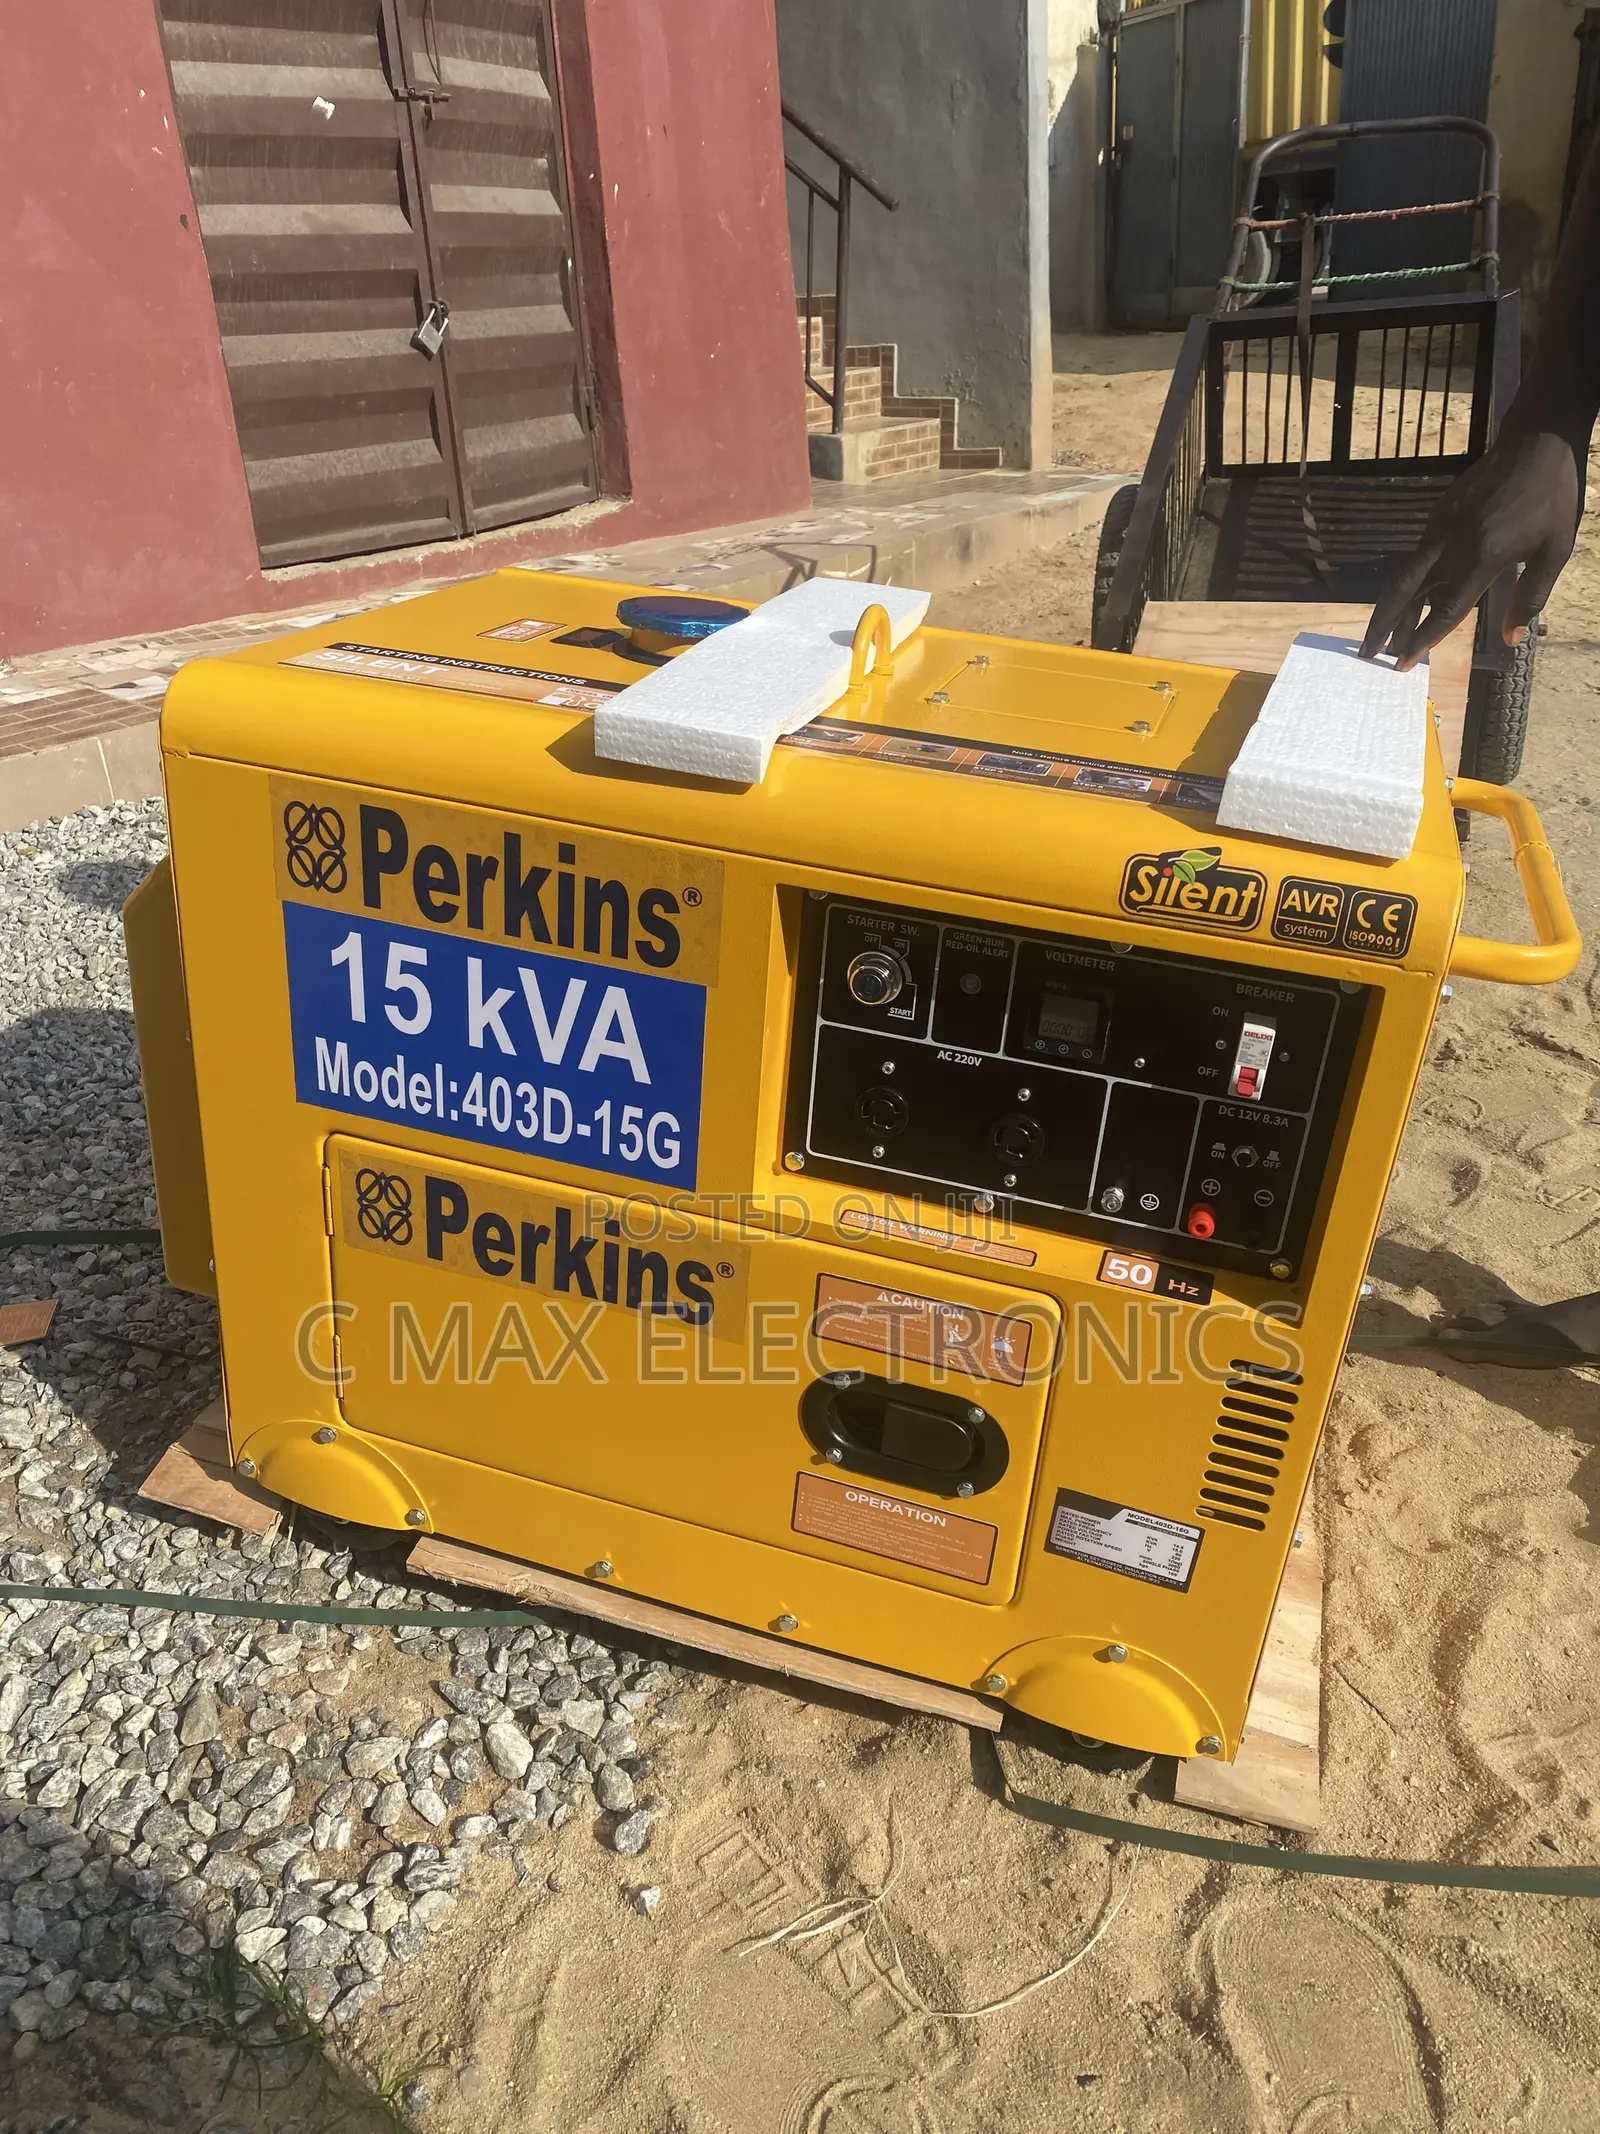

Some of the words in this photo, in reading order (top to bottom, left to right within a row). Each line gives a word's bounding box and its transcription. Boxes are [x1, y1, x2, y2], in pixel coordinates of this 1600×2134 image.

[316, 652, 449, 675] SILENT
[342, 645, 438, 662] STARTING
[440, 658, 587, 685] INSTRUCTIONS
[1040, 754, 1069, 762] Before
[1072, 759, 1105, 768] starting
[1107, 764, 1150, 775] generator
[1129, 864, 1257, 917] Silent
[1282, 888, 1339, 918] AVR
[1357, 899, 1402, 933] CE
[847, 914, 895, 932] STARTER
[900, 924, 920, 937] SW.
[1284, 921, 1328, 940] system
[864, 934, 879, 943] OFF
[894, 940, 906, 949] ON
[953, 932, 1005, 948] GREEN-RUN
[946, 941, 980, 953] RED-OIL
[982, 947, 1010, 959] ALERT
[1045, 950, 1116, 971] VOLTMETER
[1236, 984, 1294, 1003] BREAKER
[330, 932, 433, 1036] 15
[467, 956, 652, 1085] kVA
[889, 1007, 912, 1017] START
[1212, 1006, 1229, 1017] ON
[1244, 1031, 1273, 1041] DELIXI
[937, 1050, 952, 1061] AC
[954, 1053, 982, 1067] 220V
[1197, 1066, 1219, 1078] OFF
[315, 1037, 681, 1169] Model:403D-15G
[1219, 1105, 1235, 1117] DC
[1238, 1109, 1261, 1121] 12V
[1262, 1113, 1289, 1128] 8.3A
[1210, 1150, 1225, 1160] ON
[1263, 1159, 1281, 1170] OFF
[850, 1213, 877, 1223] LOW
[879, 1218, 896, 1228] OIL
[1106, 1258, 1153, 1285] 50
[1168, 1279, 1199, 1296] Hz
[891, 1294, 964, 1321] CAUTION
[845, 1490, 946, 1527] OPERATION
[1060, 1510, 1079, 1518] RATED
[1080, 1516, 1100, 1525] POWER
[1059, 1518, 1077, 1526] RATED
[1078, 1523, 1112, 1536] FREQUENCY
[1074, 1518, 1095, 1527] POWER
[1057, 1526, 1077, 1534] POWER
[1078, 1532, 1100, 1541] FACTOR
[1103, 1543, 1122, 1552] SPEED
[1142, 1559, 1161, 1567] SINGLE
[1161, 1565, 1179, 1573] PHASE
